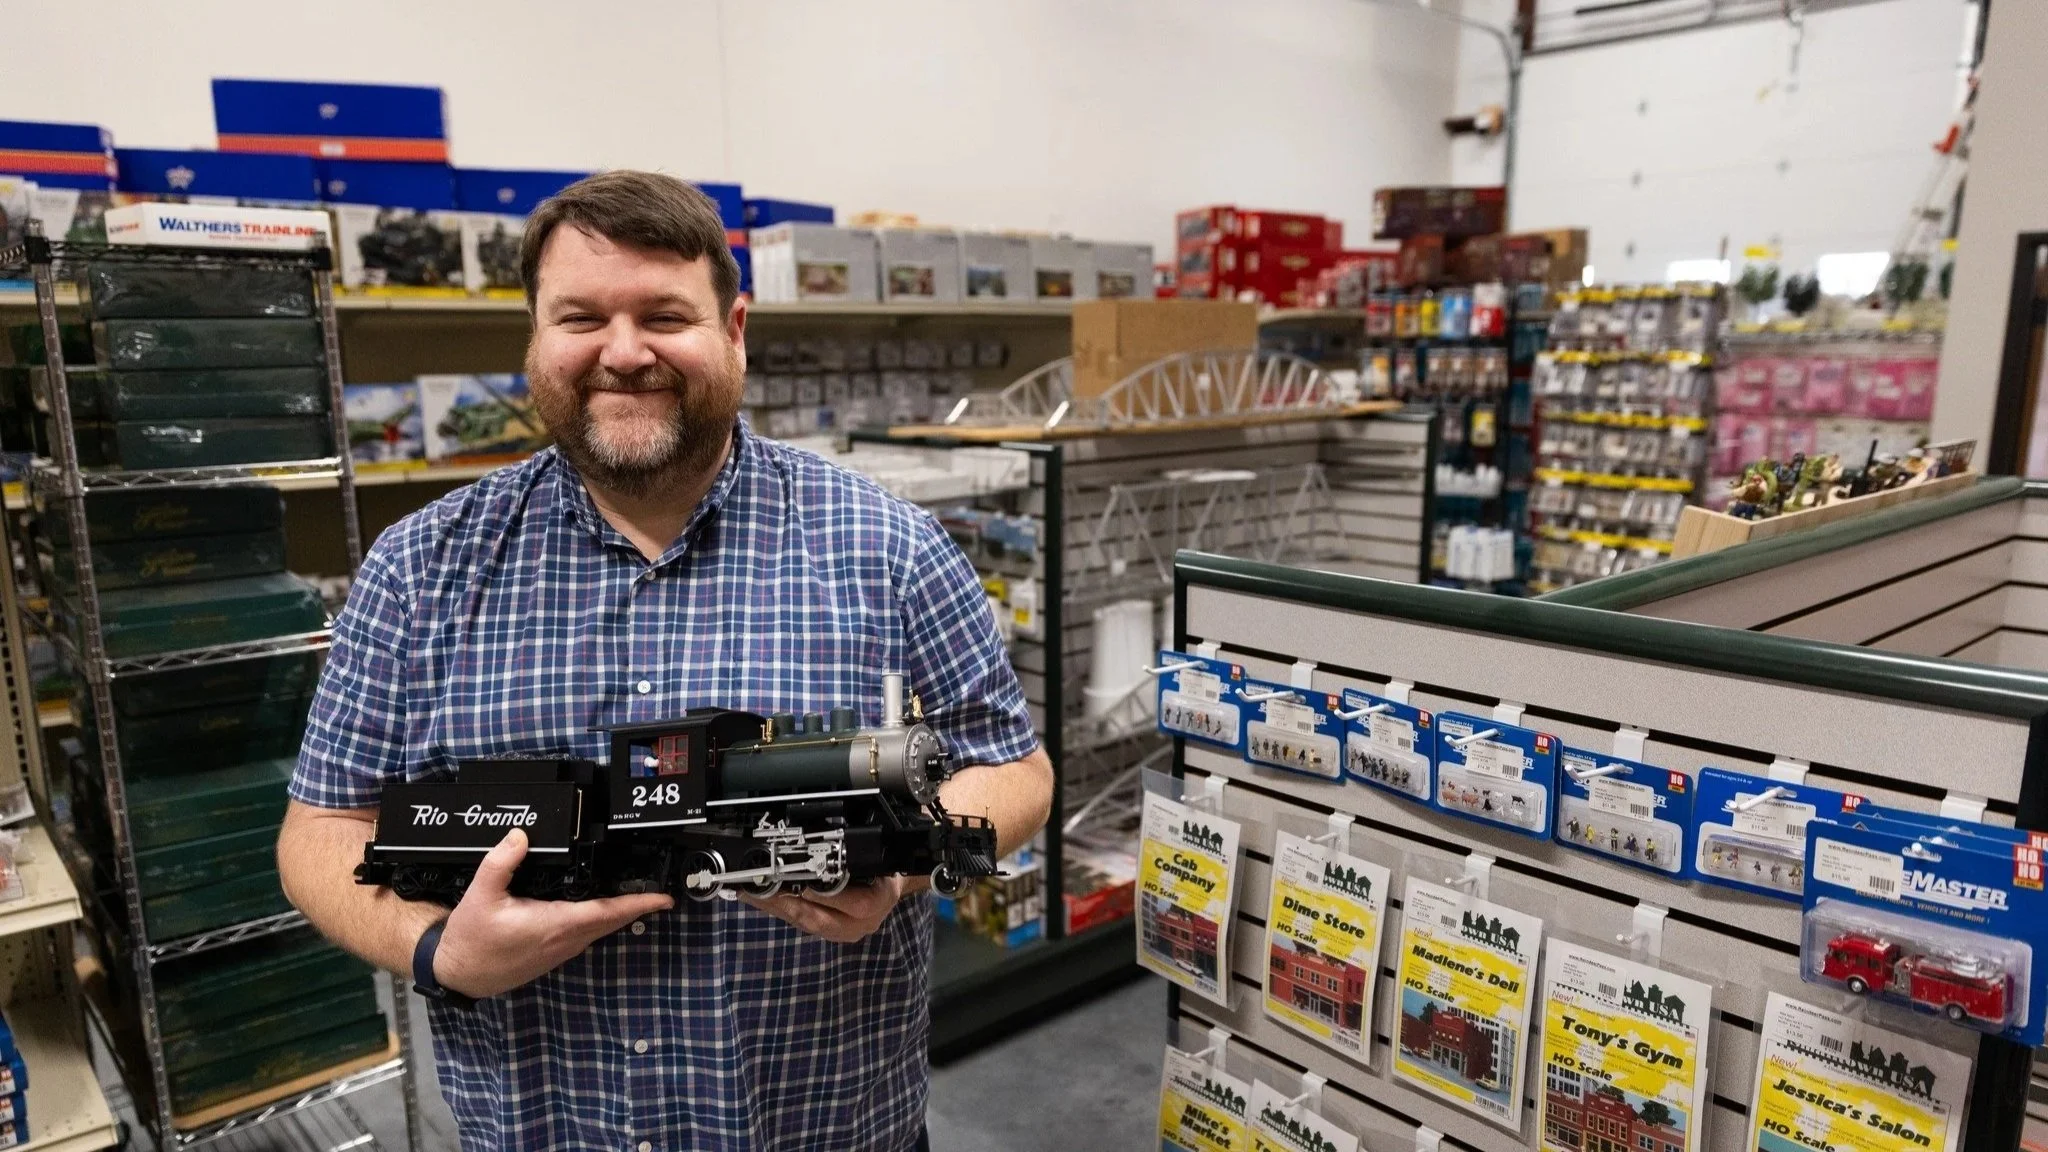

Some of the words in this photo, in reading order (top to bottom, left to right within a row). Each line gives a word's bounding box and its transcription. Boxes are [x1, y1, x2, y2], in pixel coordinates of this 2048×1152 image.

[1420, 711, 1429, 722] HO
[1536, 735, 1549, 748] HO
[1670, 773, 1684, 787] HO
[632, 783, 680, 807] 248
[1845, 794, 1861, 809] HO
[410, 804, 448, 826] Rio
[454, 804, 537, 826] Grande
[1173, 853, 1198, 872] Cab
[2017, 846, 2039, 864] HO
[1154, 857, 1216, 893] Company
[2018, 861, 2041, 881] HO
[1144, 881, 1158, 892] HO
[1159, 888, 1179, 901] Scale
[1900, 869, 2008, 907] EMASTER
[1282, 895, 1320, 921] Dime
[1323, 912, 1366, 940] Store
[1276, 921, 1292, 934] HO
[1294, 930, 1318, 945] Scale
[1490, 933, 1517, 952] USA
[1412, 944, 1485, 980] Madlene's
[1488, 973, 1520, 994] Deli
[1405, 977, 1424, 990] HO
[1427, 985, 1455, 1004] Scale
[1551, 990, 1575, 1004] New!
[1652, 1000, 1681, 1021] USA
[1562, 1015, 1629, 1050] Tony's
[1633, 1040, 1684, 1070] Gym
[1553, 1052, 1576, 1067] HO
[1578, 1061, 1613, 1081] Scale
[1770, 1054, 1798, 1069] New!
[1890, 1070, 1928, 1094] USA
[1185, 1103, 1229, 1135] Mike's
[1773, 1079, 1863, 1121] Jessica's
[1867, 1113, 1931, 1147] Salon
[1181, 1114, 1231, 1150] Market
[1763, 1118, 1791, 1136] HO
[1793, 1130, 1836, 1152] Scale
